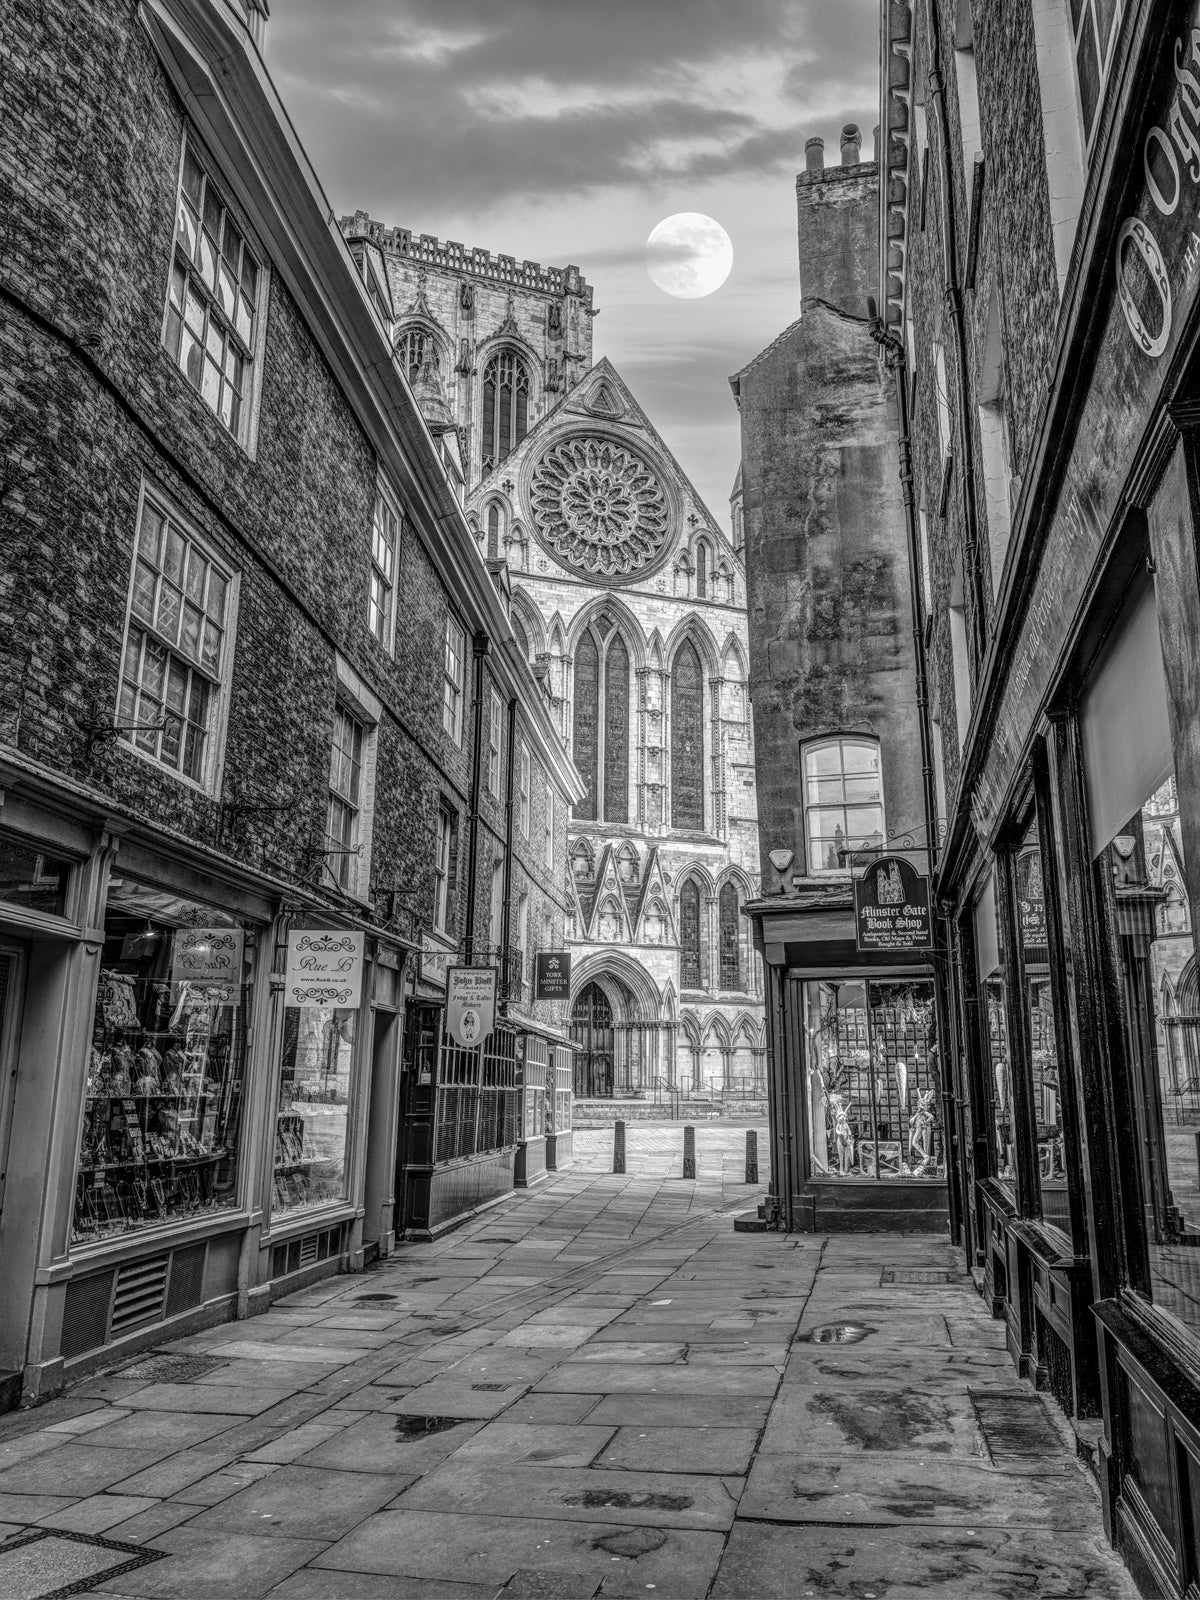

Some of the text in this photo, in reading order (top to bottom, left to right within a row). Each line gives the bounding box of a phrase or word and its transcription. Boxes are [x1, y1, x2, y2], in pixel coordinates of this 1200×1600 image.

[861, 905, 927, 918] Minster Gate
[866, 917, 922, 930] Book Shop
[292, 955, 358, 972] Rue B
[453, 976, 473, 986] John
